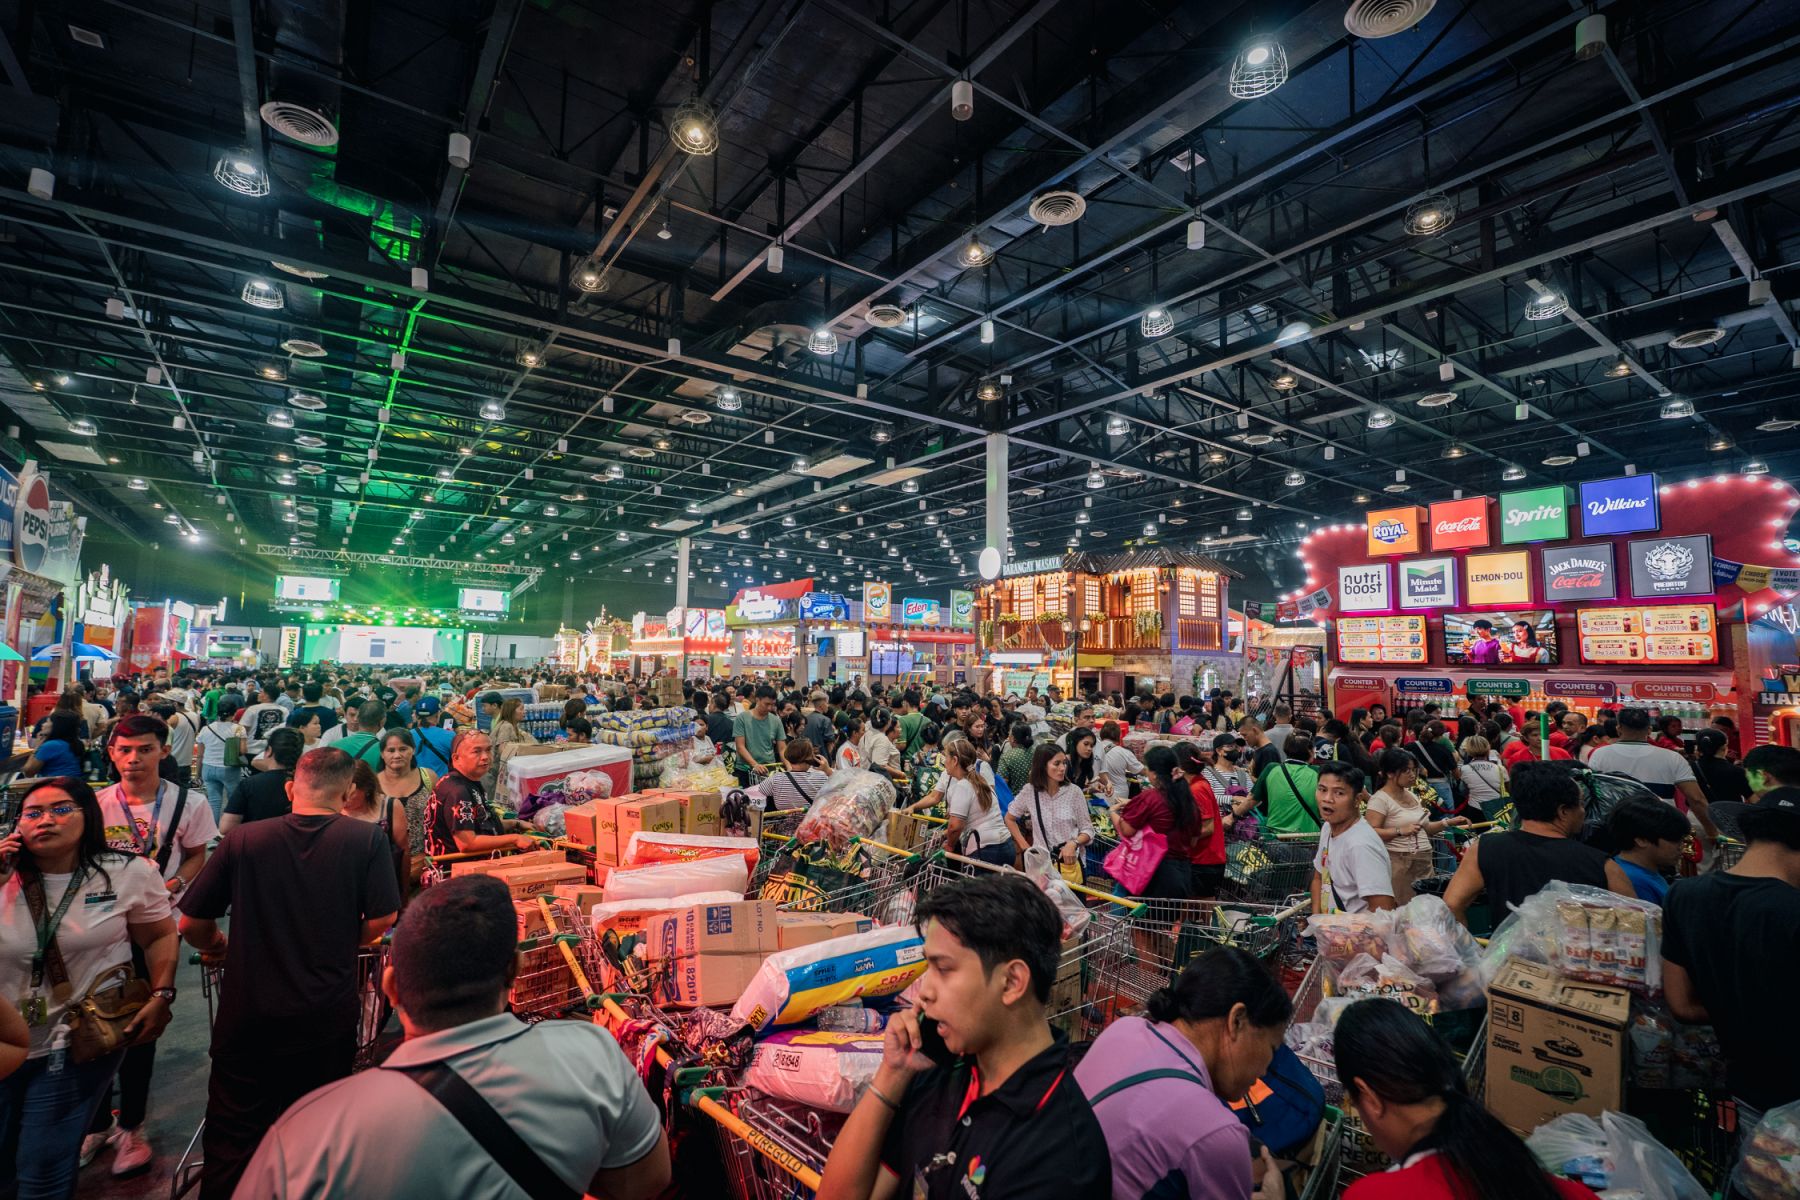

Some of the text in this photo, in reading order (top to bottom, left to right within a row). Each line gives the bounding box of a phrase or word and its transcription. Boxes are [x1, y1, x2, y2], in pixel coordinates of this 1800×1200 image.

[1588, 497, 1648, 516] Wilkins
[1505, 504, 1562, 526] Sprite
[22, 511, 48, 541] PEPSI
[1372, 524, 1408, 540] ROYAL
[1435, 516, 1483, 535] Coca-Cola
[1548, 558, 1608, 576] JACK DANIEL'S
[1344, 571, 1381, 584] nutri
[1410, 578, 1442, 586] Minute
[1470, 572, 1523, 582] LEMON-DOU
[1552, 573, 1604, 590] Coca-Cola
[1344, 582, 1382, 596] boost
[1414, 585, 1439, 593] Maid
[812, 604, 834, 614] OREO
[906, 602, 928, 615] Eden
[527, 882, 545, 894] Eden
[686, 910, 694, 921] 10
[686, 968, 697, 1002] 82010
[1512, 1011, 1520, 1022] 8
[748, 1130, 802, 1174] PUREGOLD
